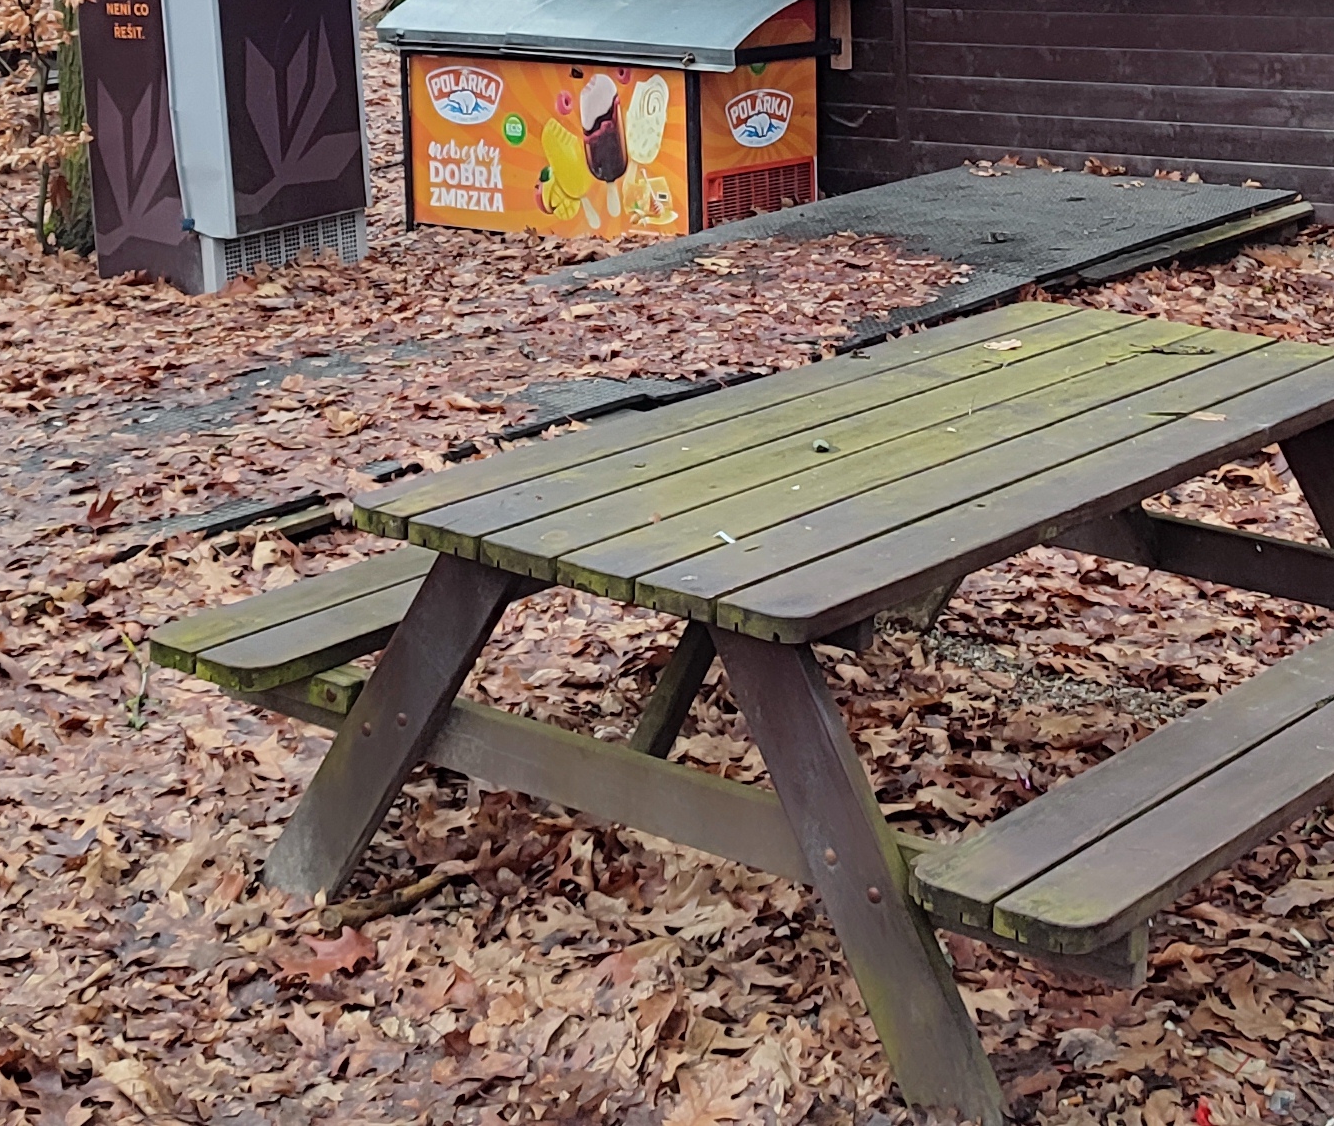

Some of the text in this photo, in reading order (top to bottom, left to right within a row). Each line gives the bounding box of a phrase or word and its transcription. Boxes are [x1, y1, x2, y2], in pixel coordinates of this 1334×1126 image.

[106, 0, 149, 16] NENÍ CO
[430, 187, 505, 213] ZMRZKA
